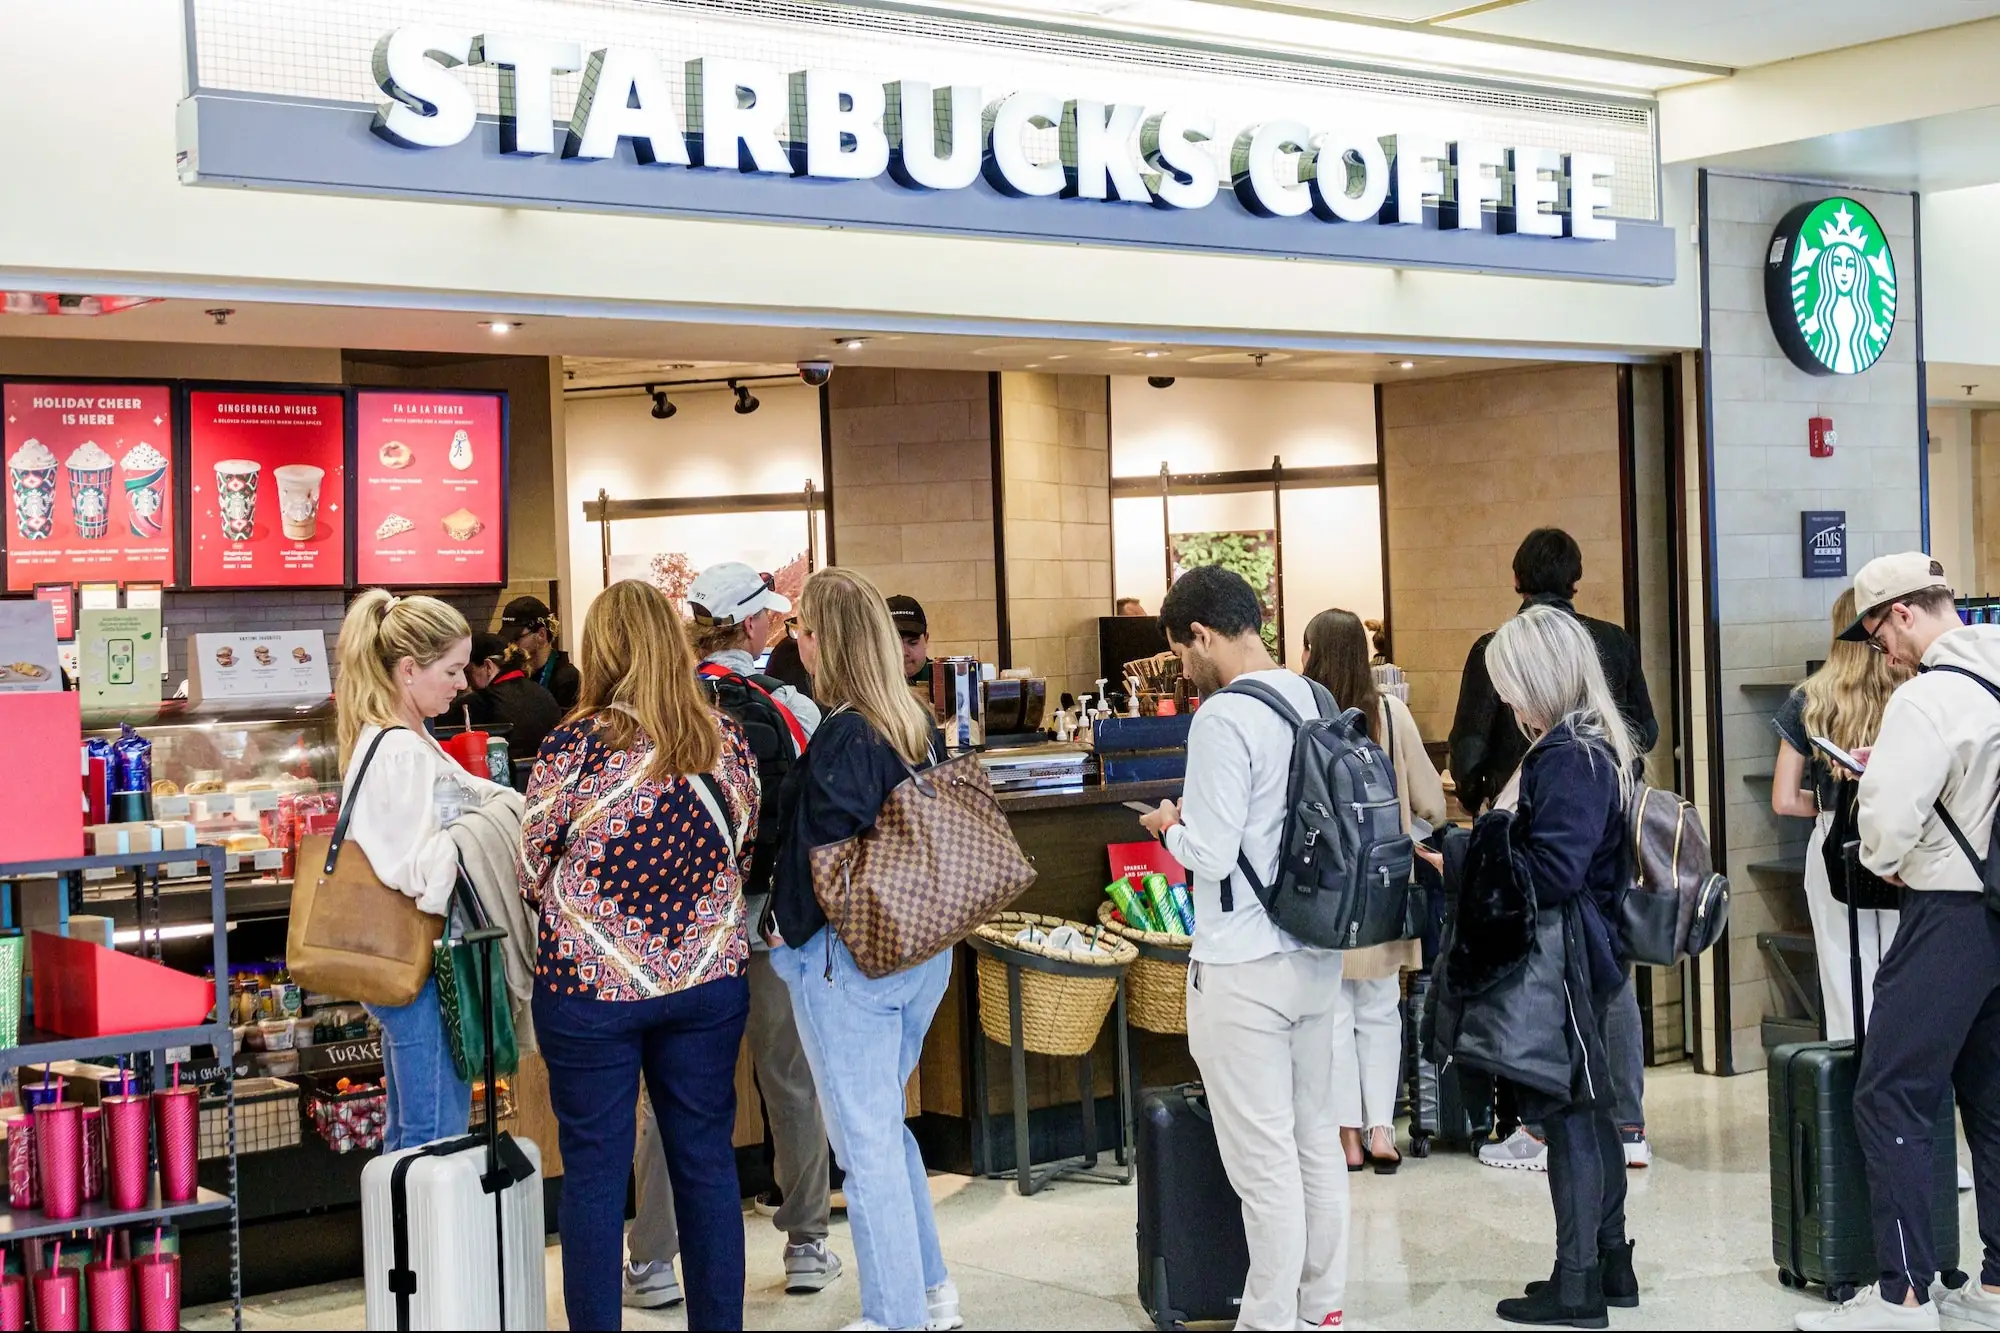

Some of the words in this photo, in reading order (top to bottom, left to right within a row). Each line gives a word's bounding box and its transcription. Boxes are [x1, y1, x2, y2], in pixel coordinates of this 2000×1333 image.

[370, 25, 1218, 209] STARBUCKS
[1231, 119, 1617, 241] COFFEE
[33, 397, 93, 409] HOLIDAY
[97, 398, 142, 409] CHEER
[217, 403, 281, 414] GINGERBREAD
[284, 405, 318, 415] WISHES
[393, 404, 404, 413] FA
[406, 404, 417, 414] LA
[420, 405, 430, 414] LA
[433, 405, 463, 415] TREATS
[62, 414, 76, 425] IS
[79, 414, 114, 425] HERE
[1815, 532, 1841, 547] HMS
[1123, 864, 1147, 872] SPARKLE
[325, 1042, 382, 1065] TURKE
